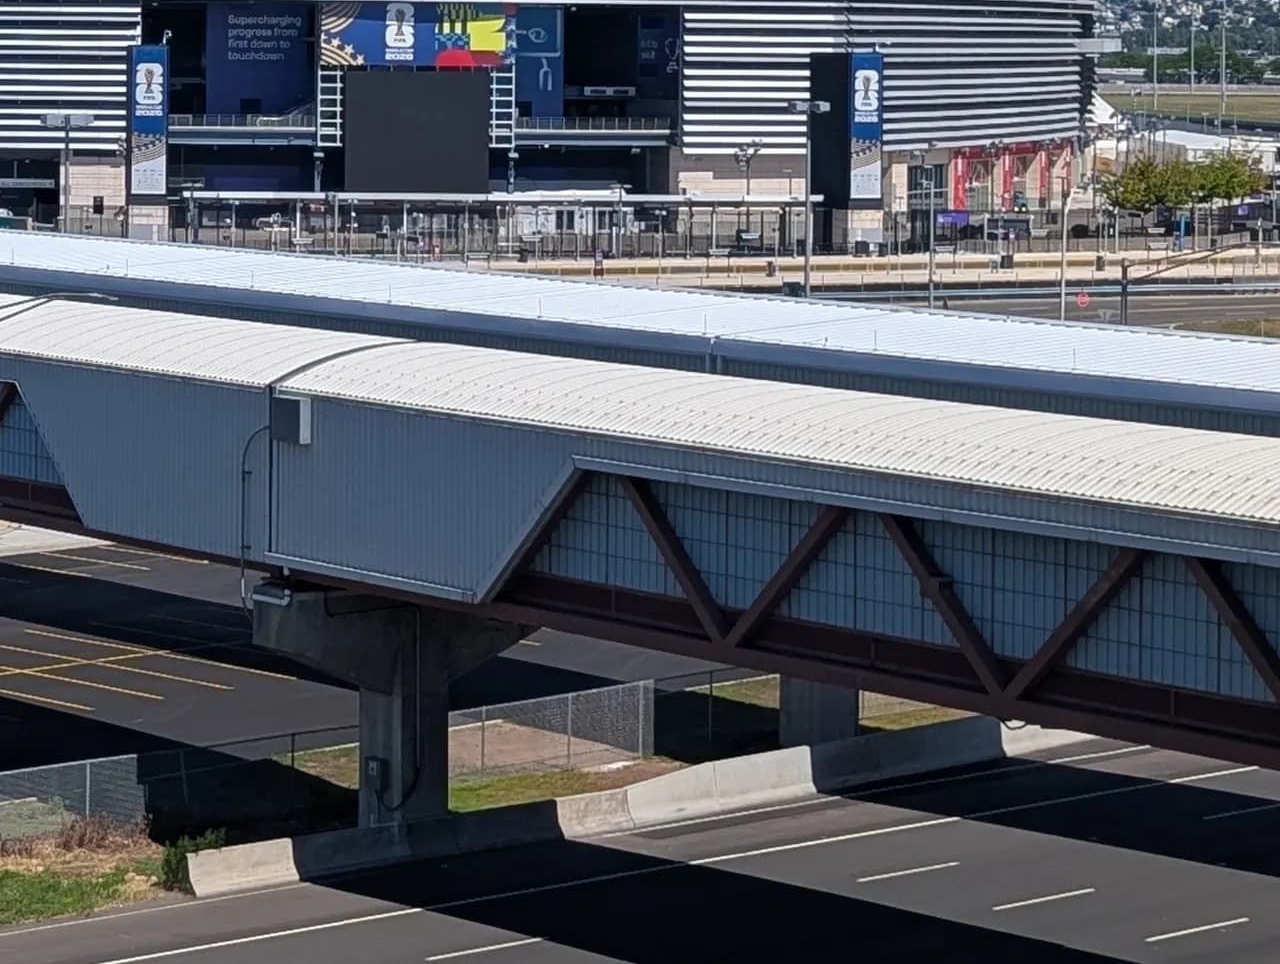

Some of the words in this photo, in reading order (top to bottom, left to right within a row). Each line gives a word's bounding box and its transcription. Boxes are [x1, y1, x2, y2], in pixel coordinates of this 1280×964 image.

[228, 14, 302, 27] Supercharging
[228, 28, 273, 38] progress
[274, 27, 298, 37] from
[228, 38, 248, 48] first
[250, 38, 278, 48] down
[280, 40, 291, 48] to
[228, 51, 285, 60] touchdown
